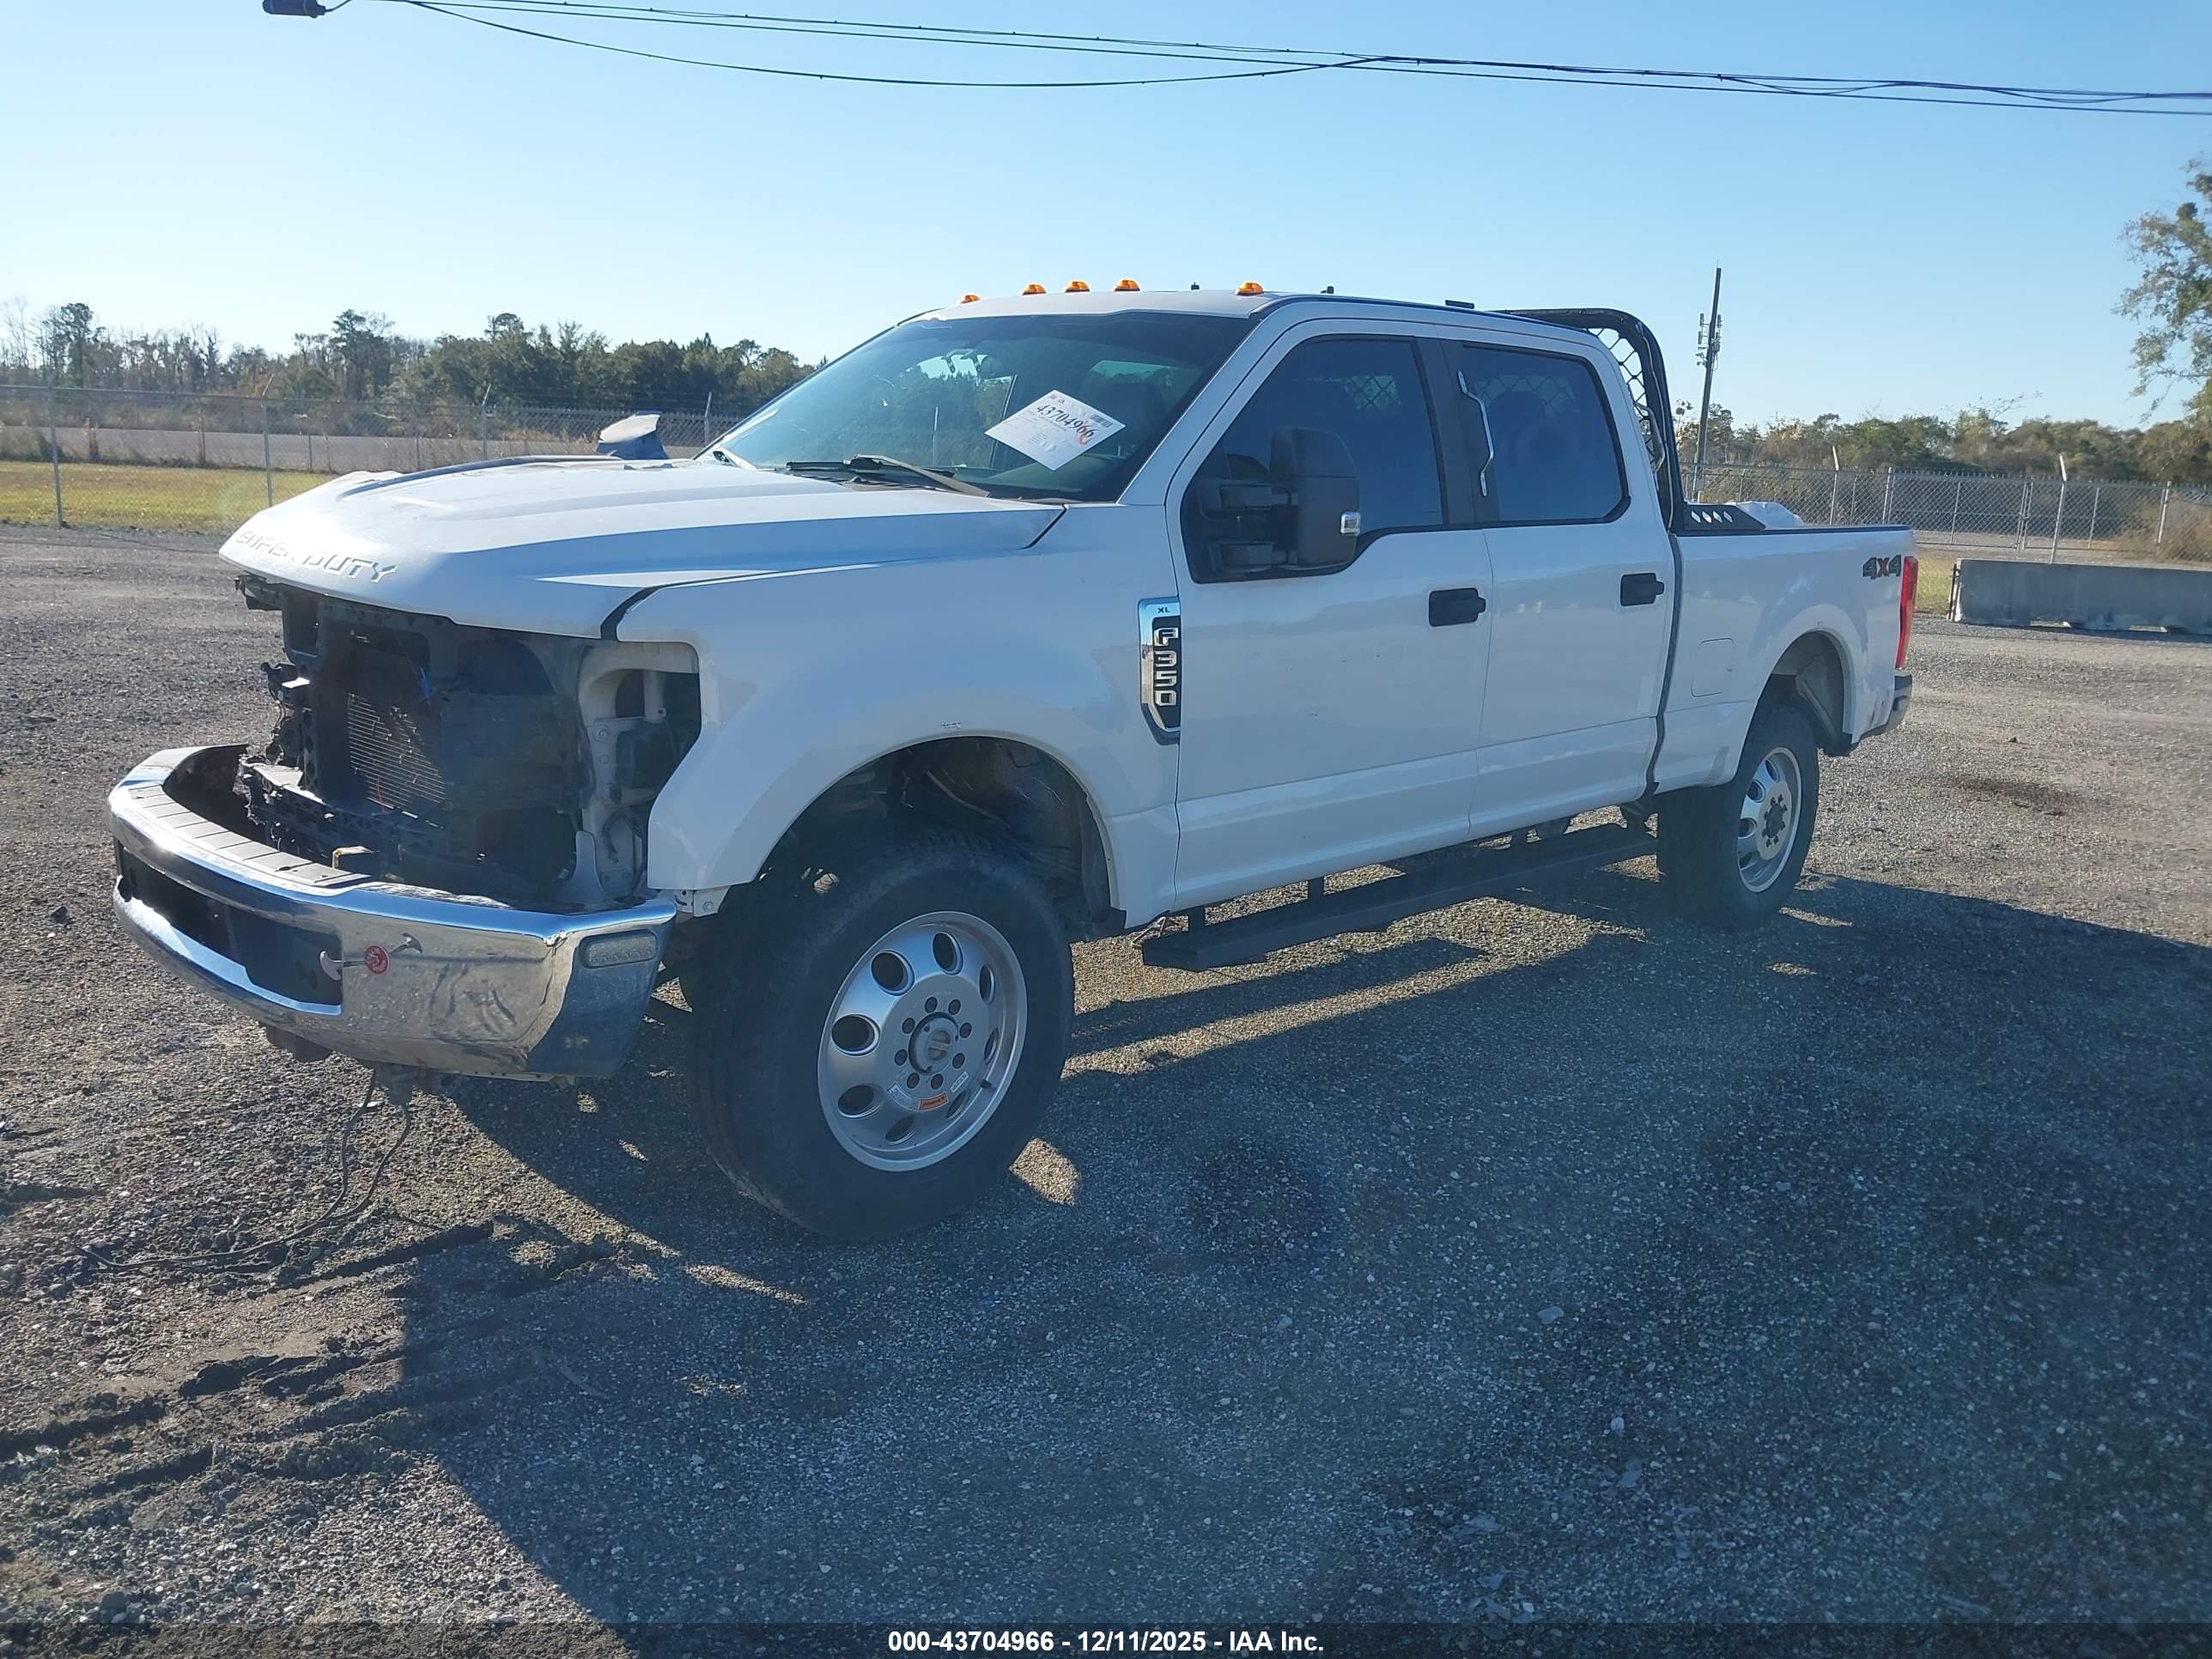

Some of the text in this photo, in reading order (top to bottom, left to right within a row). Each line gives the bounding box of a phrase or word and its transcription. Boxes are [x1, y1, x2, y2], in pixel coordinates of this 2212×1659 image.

[1036, 404, 1100, 439] 43704966
[236, 531, 399, 584] SUPE DUTY
